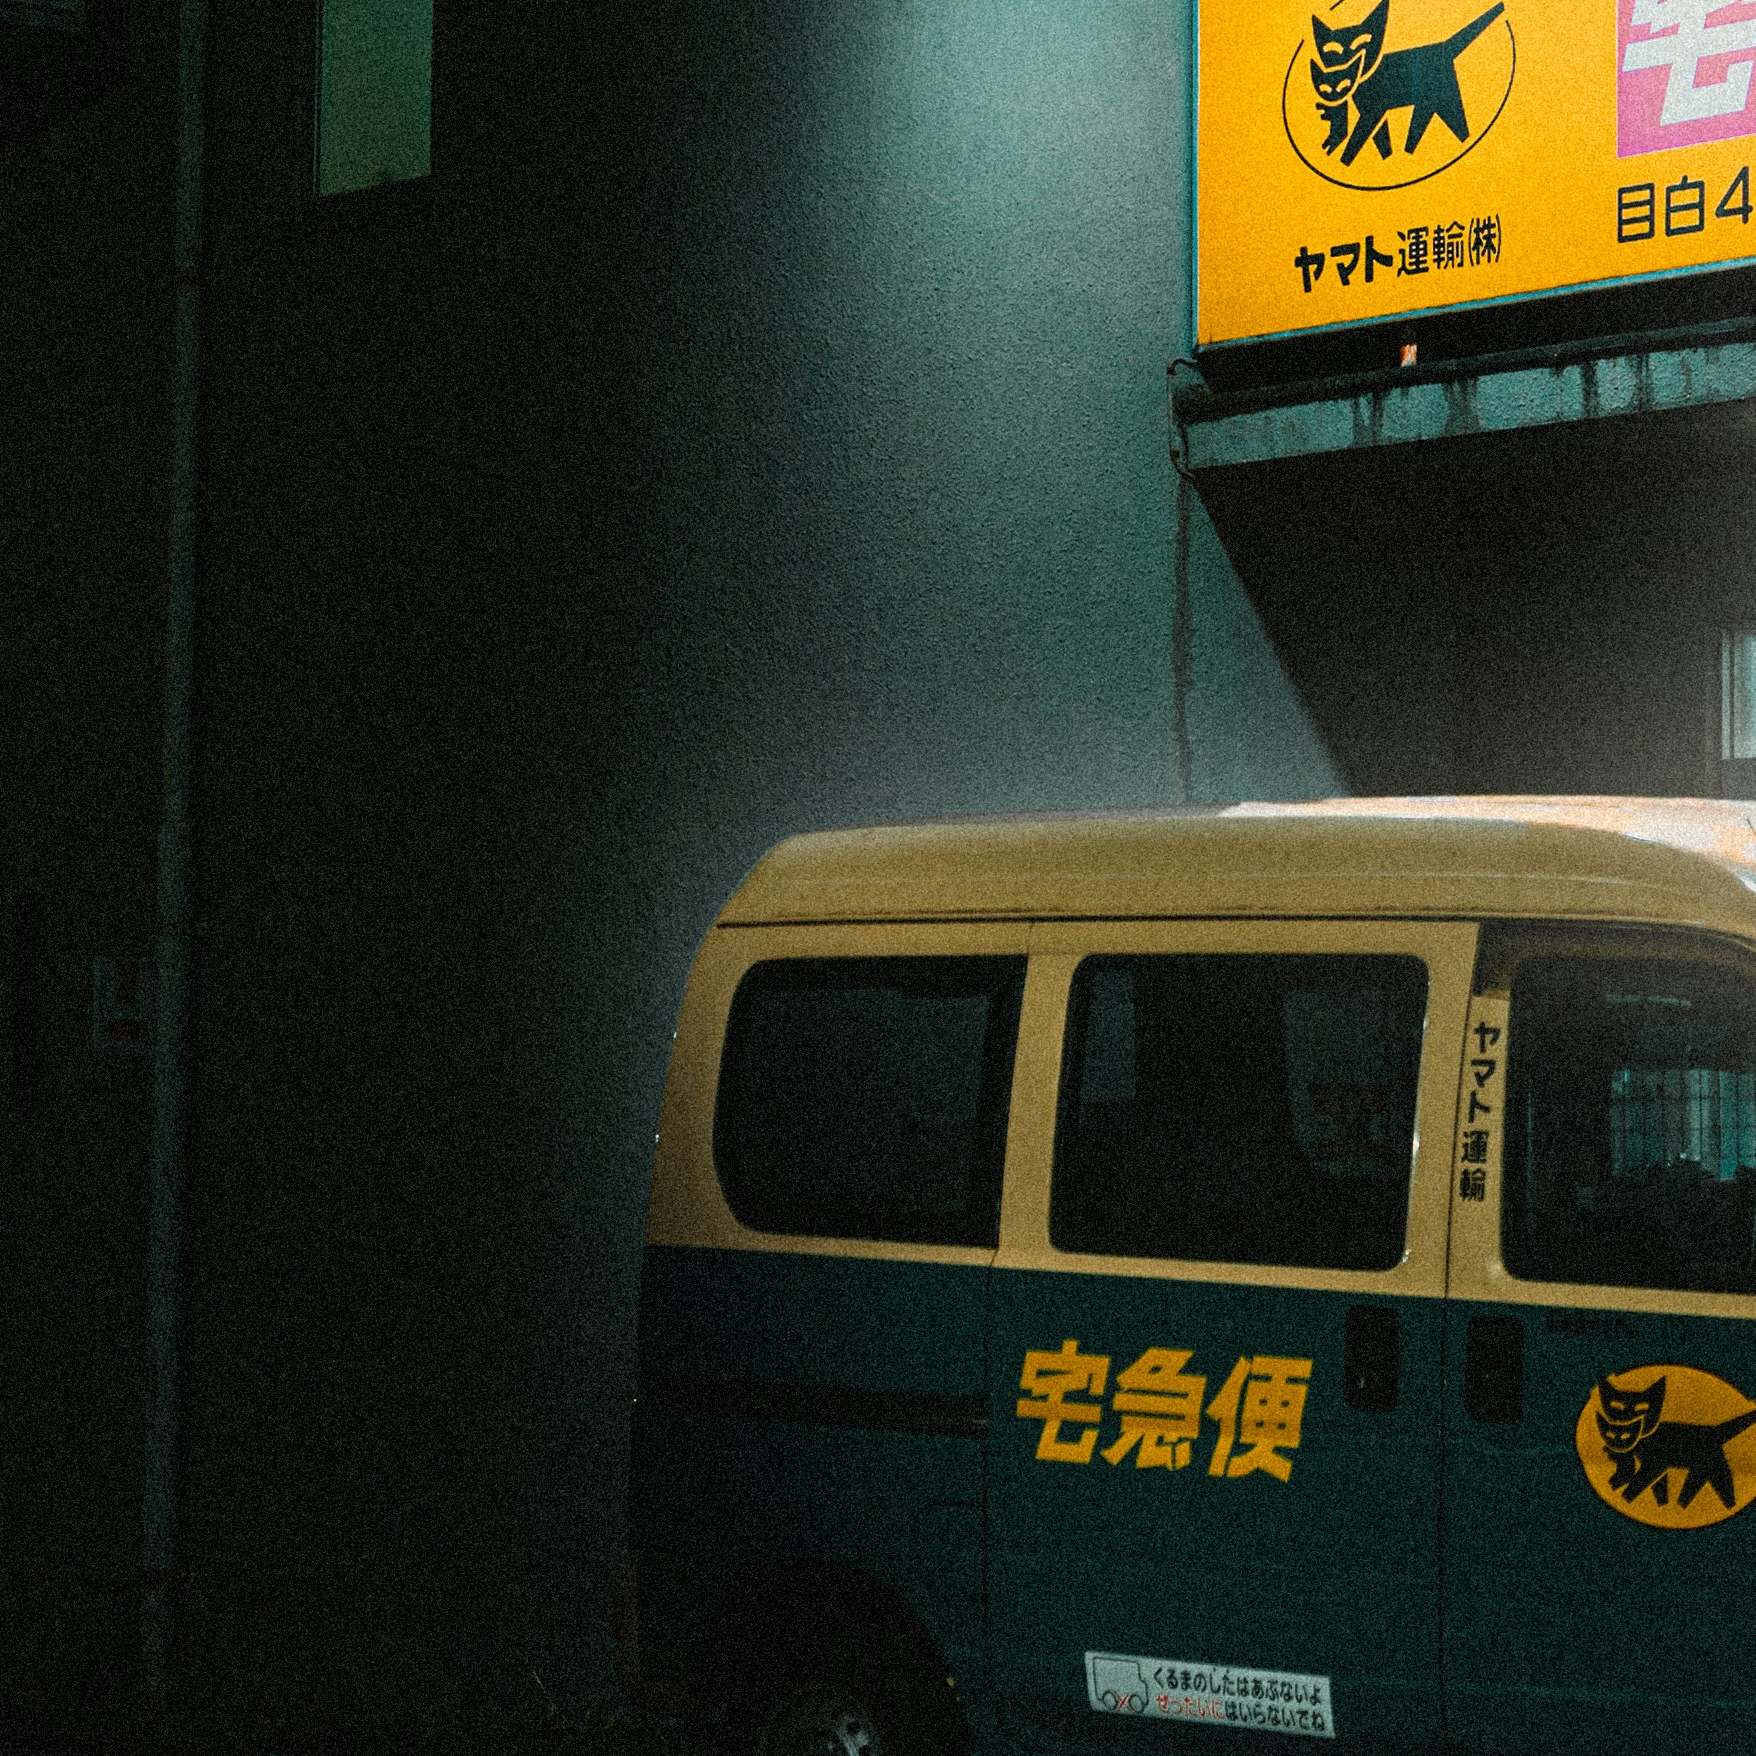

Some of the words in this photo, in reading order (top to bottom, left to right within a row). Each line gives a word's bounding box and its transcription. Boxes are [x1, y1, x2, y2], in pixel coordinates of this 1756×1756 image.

[1458, 1021, 1501, 1202] ヤマト運輸
[1016, 1339, 1314, 1483] 宅急便
[1153, 1666, 1322, 1706] くるまのしたはあぶないよ
